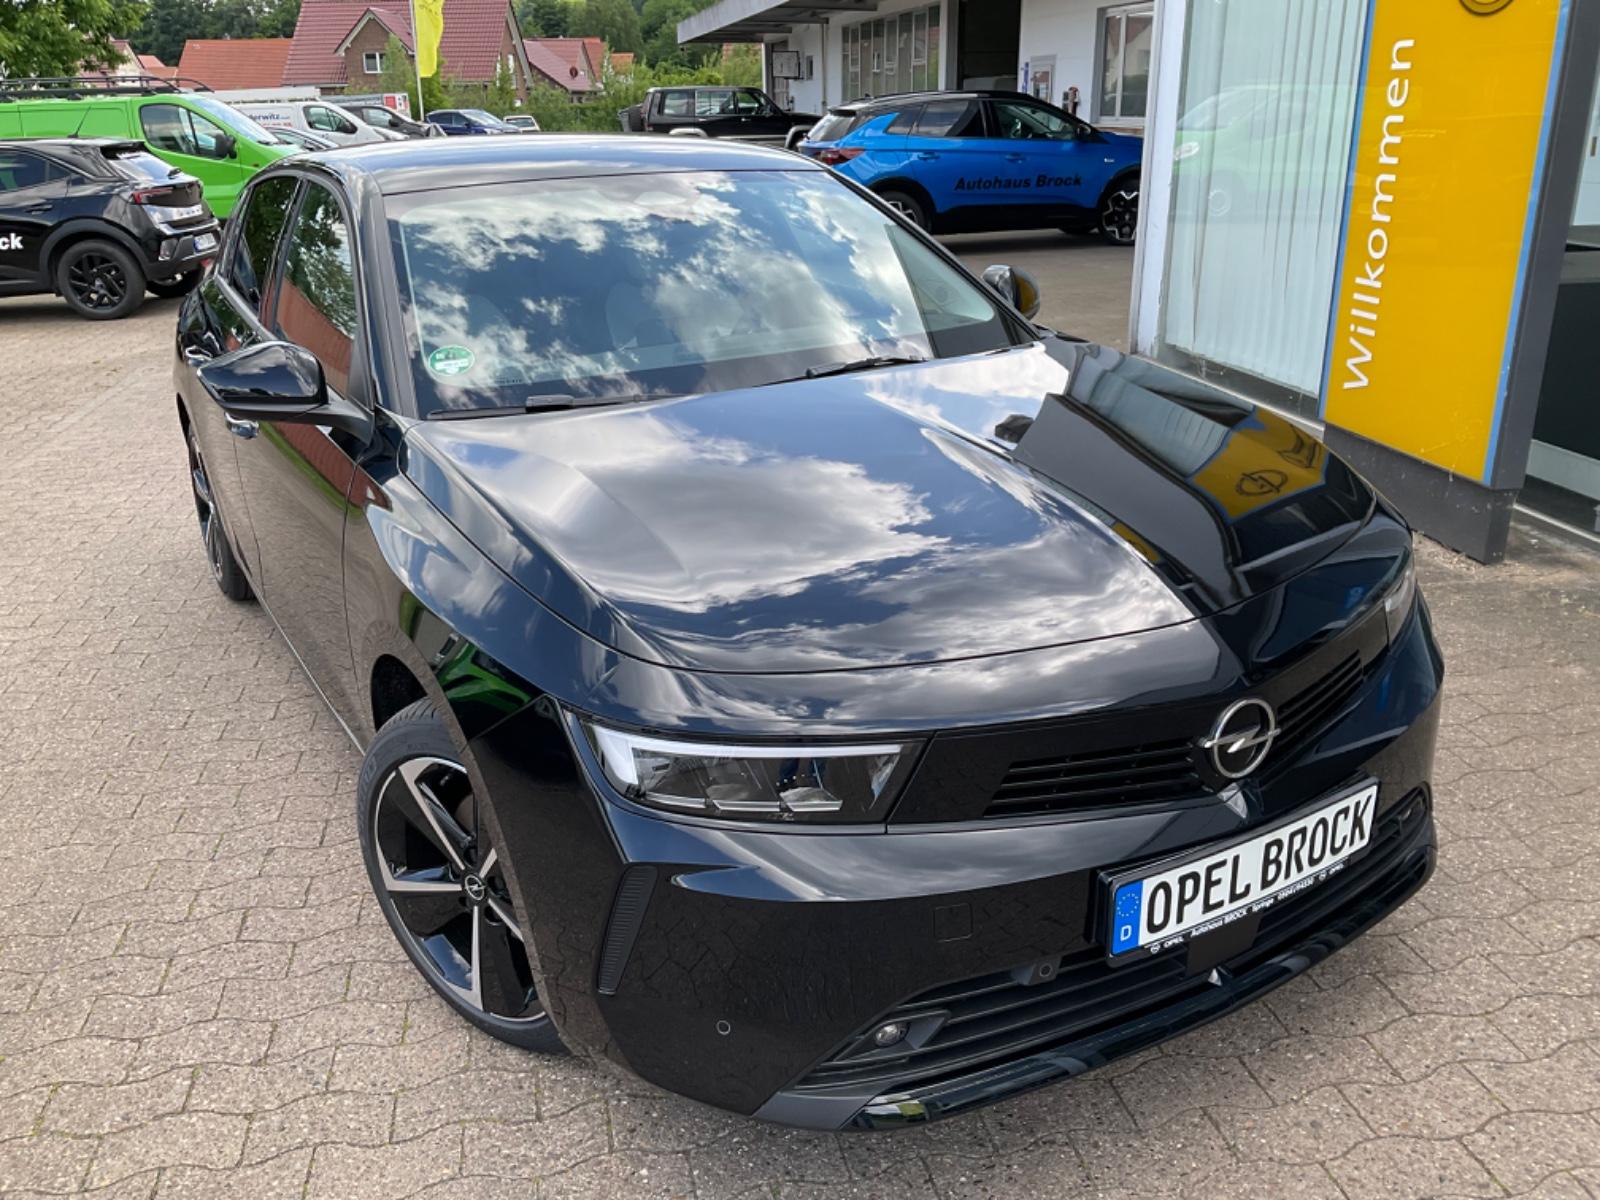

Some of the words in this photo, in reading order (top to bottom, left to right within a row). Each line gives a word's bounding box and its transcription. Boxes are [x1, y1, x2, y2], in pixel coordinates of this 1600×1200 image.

[954, 176, 1031, 191] Autohaus
[1035, 174, 1082, 188] Brock
[1343, 38, 1415, 390] Willkommen
[1147, 854, 1251, 934] OPEL
[1260, 794, 1372, 890] BROCK
[1120, 924, 1132, 941] D
[1163, 936, 1184, 949] OPEL
